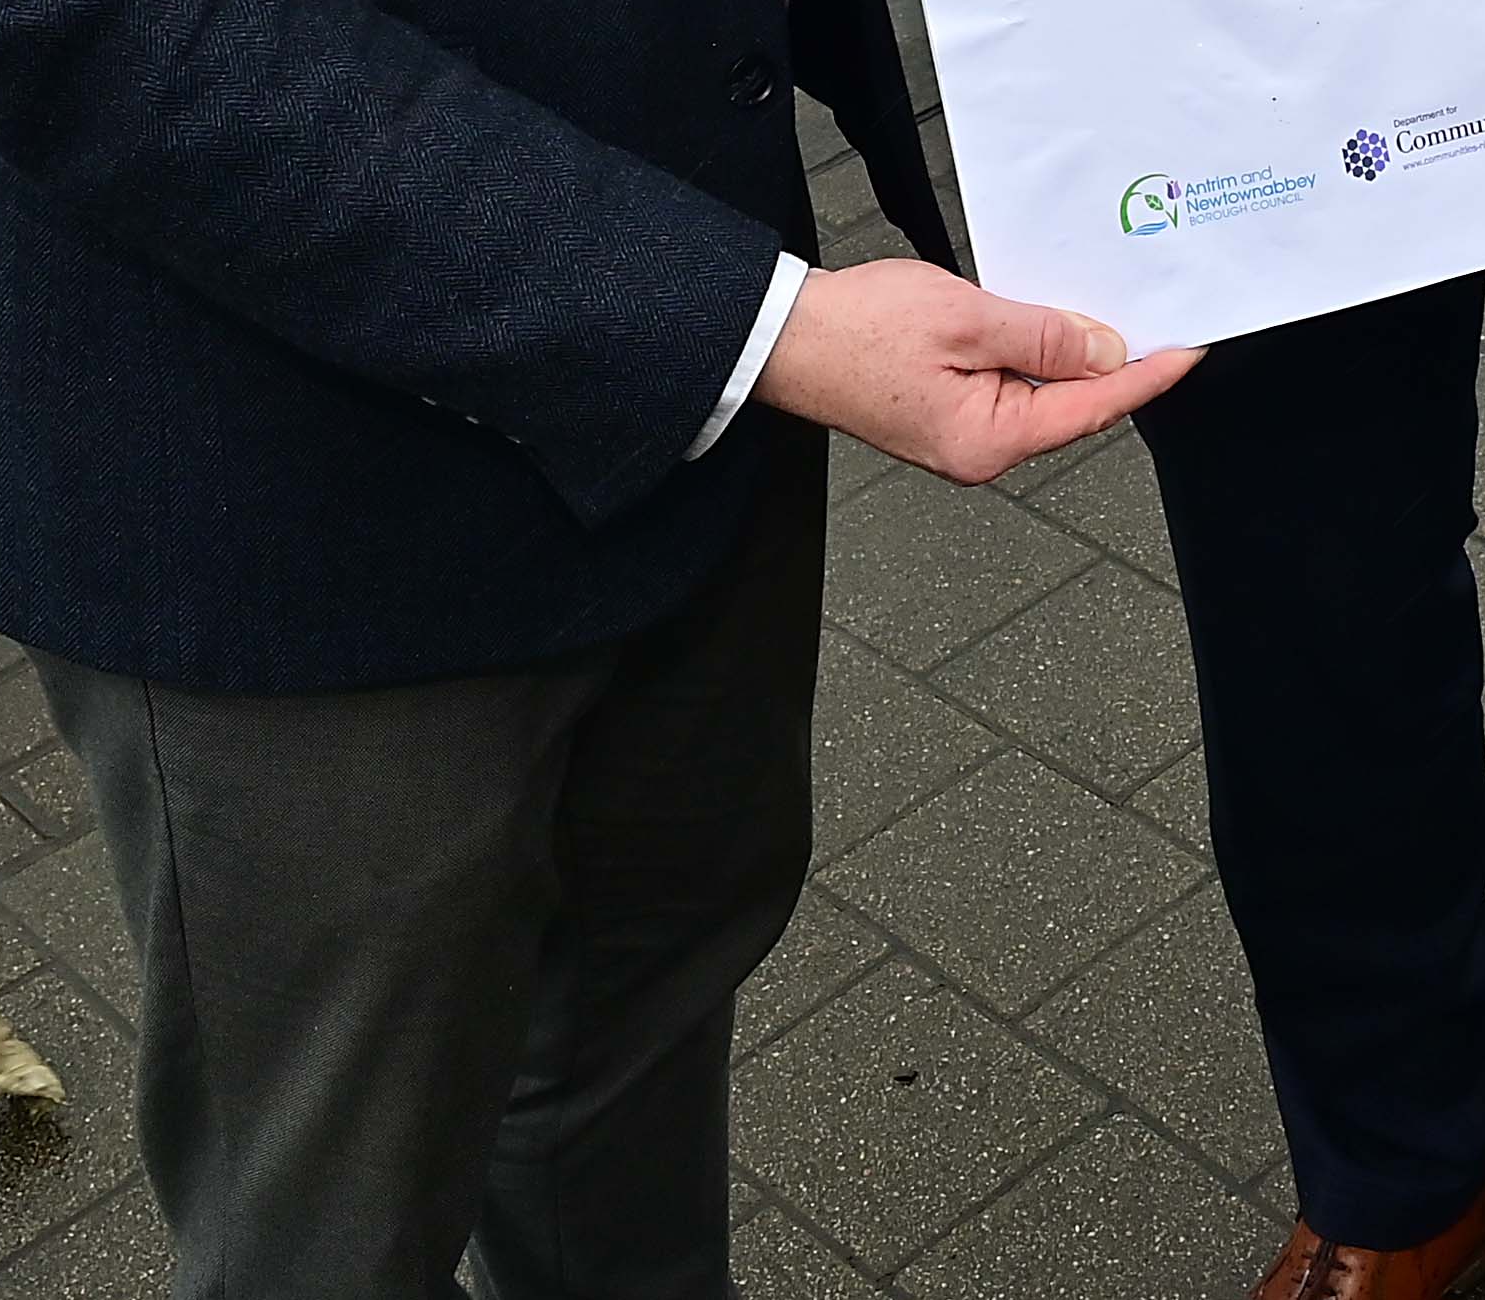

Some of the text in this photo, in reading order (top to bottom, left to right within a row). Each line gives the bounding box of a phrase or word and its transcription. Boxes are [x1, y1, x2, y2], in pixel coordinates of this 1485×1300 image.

[1393, 105, 1458, 129] Department for
[1185, 165, 1273, 199] Antrim and
[1185, 173, 1316, 214] Newtownabbey
[1188, 192, 1304, 227] BOROUGH COUNCIL
